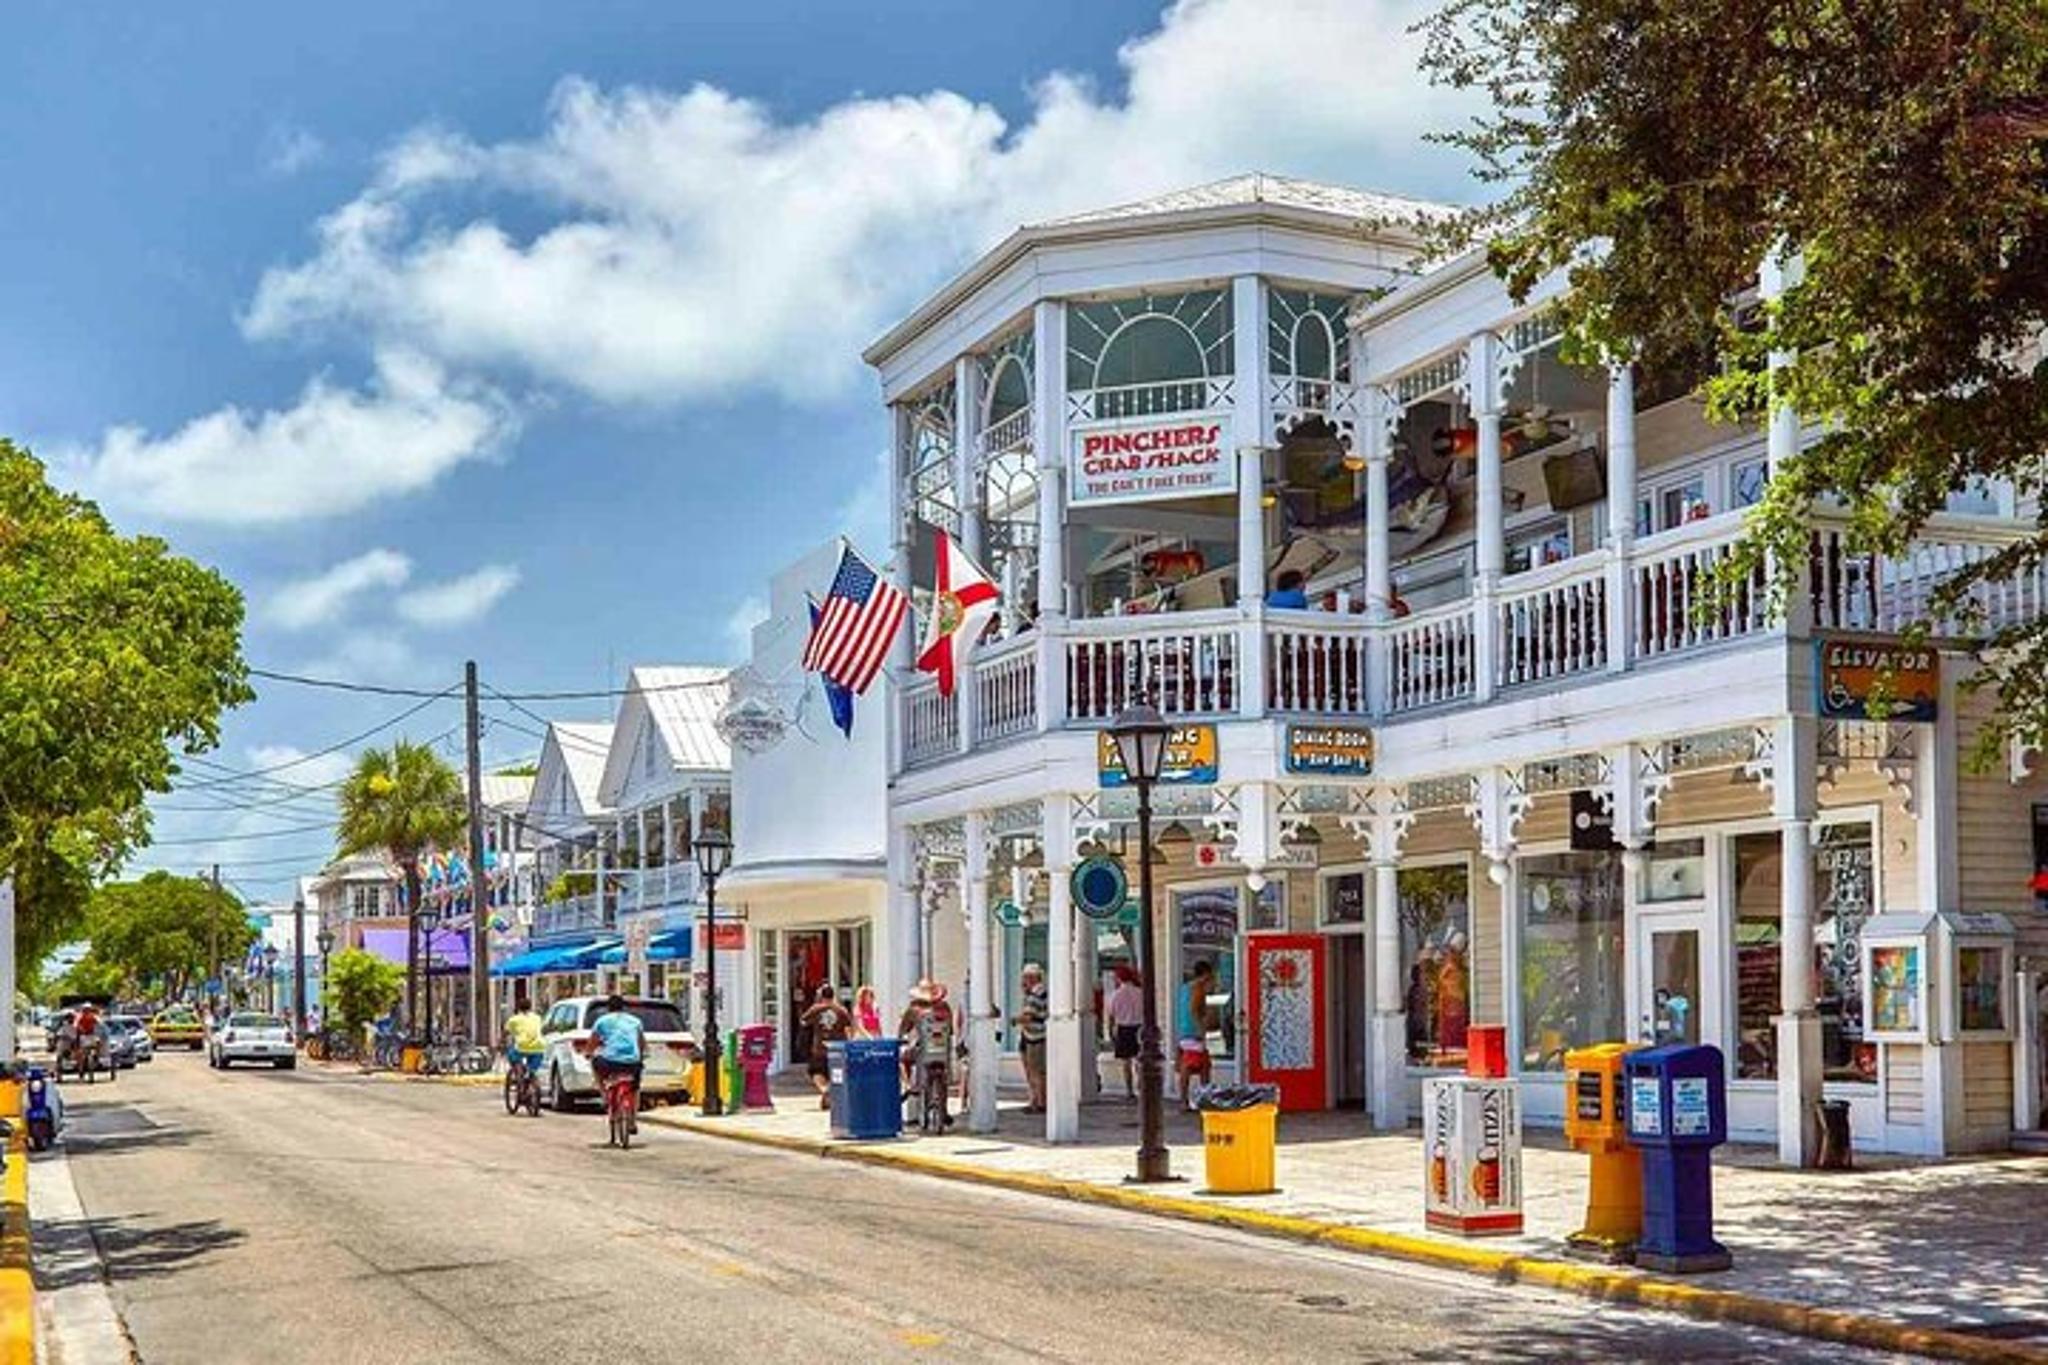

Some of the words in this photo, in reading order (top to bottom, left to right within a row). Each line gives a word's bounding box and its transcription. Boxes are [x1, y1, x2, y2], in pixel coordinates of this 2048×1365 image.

[1084, 425, 1221, 458] PINCHERS
[1084, 455, 1142, 476] CRAB
[1145, 448, 1221, 469] SHACK
[1830, 647, 1930, 671] ELEVATOR
[1477, 1089, 1500, 1164] CITIZEN
